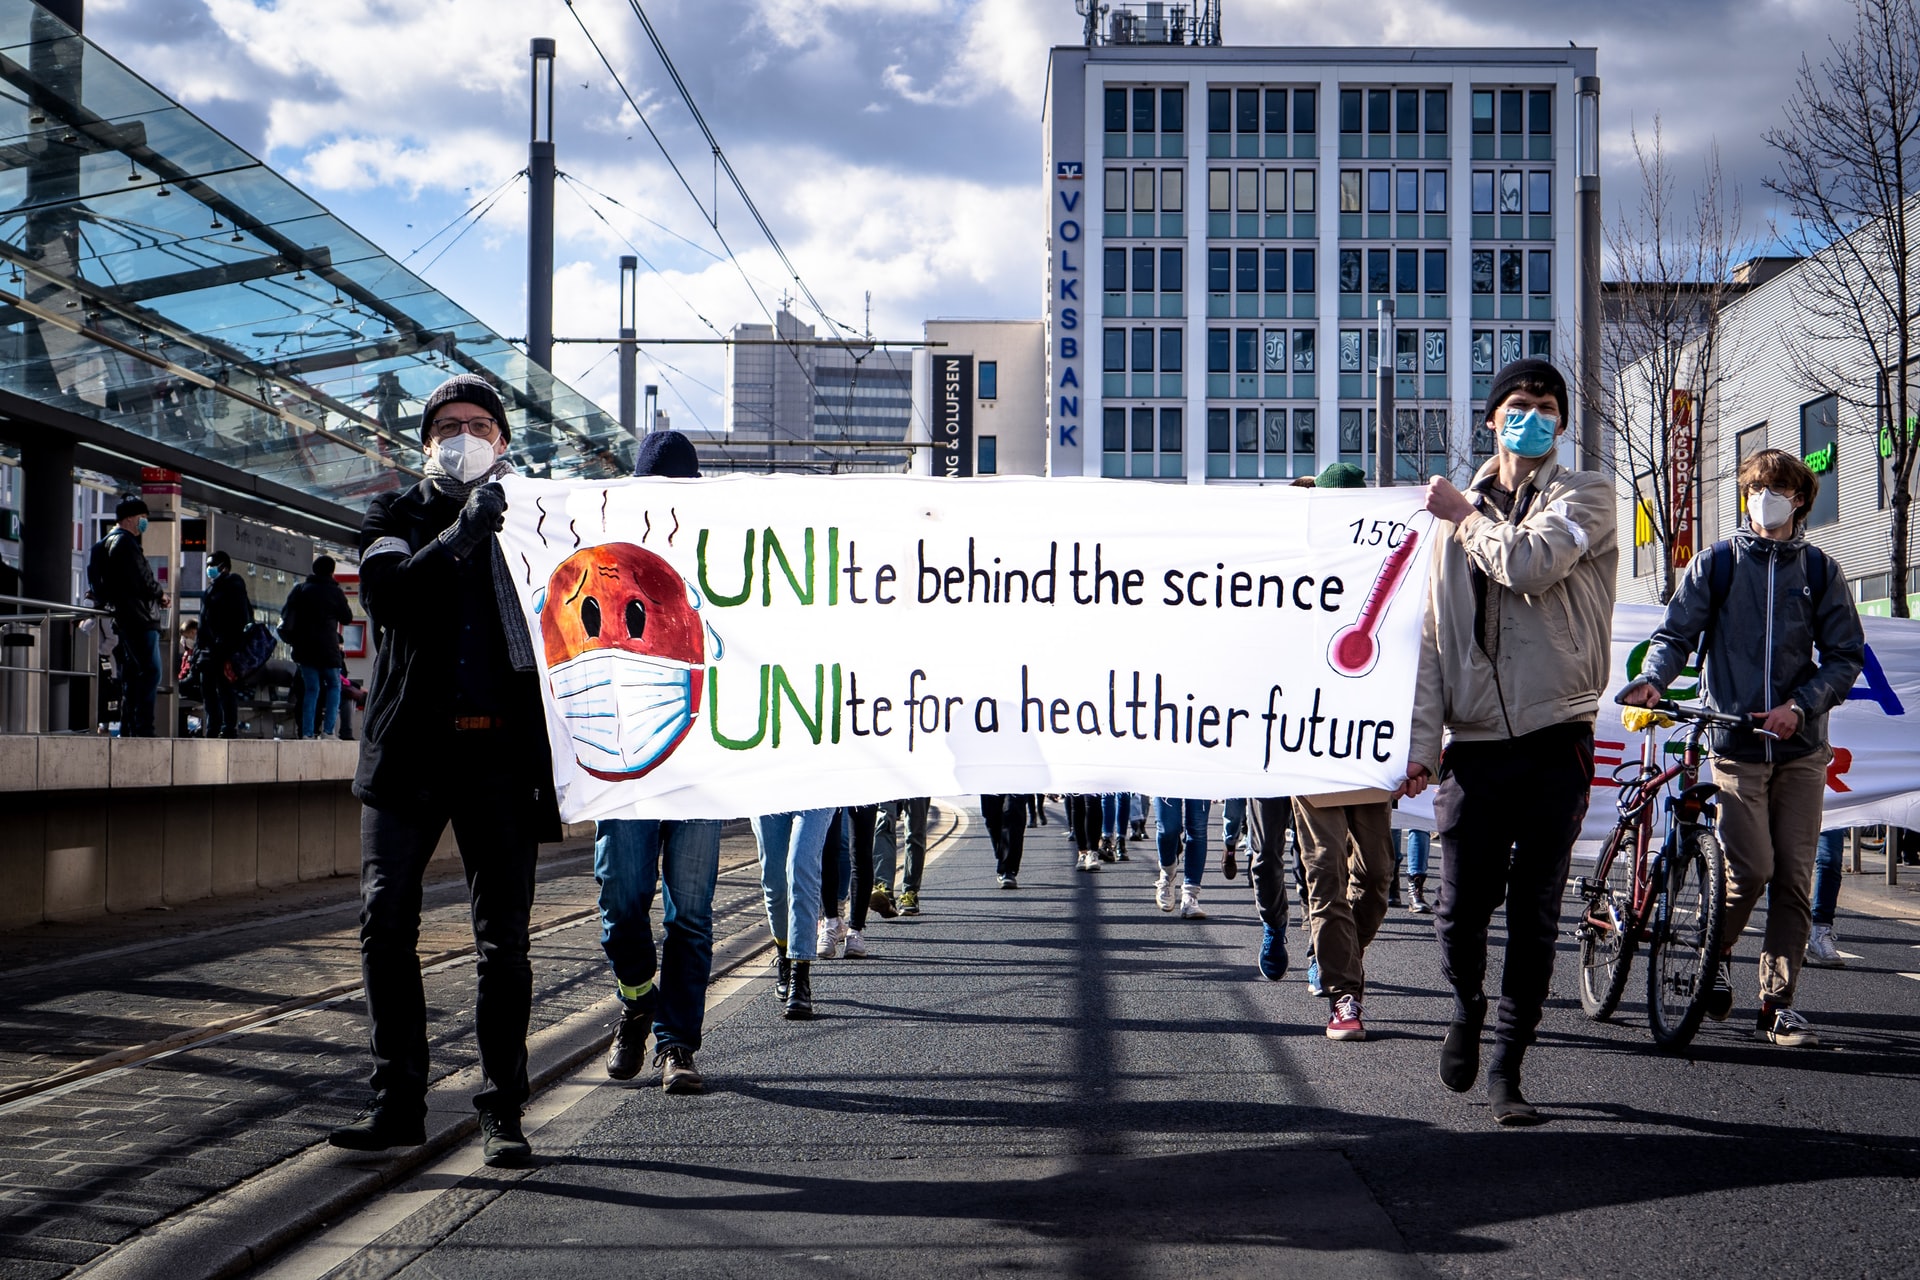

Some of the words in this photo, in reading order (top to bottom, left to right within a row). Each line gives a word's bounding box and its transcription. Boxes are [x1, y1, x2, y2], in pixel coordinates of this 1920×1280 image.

[1059, 190, 1080, 447] VOLKSBANK
[946, 360, 959, 434] OLUFSEN
[946, 439, 959, 449] &
[697, 526, 897, 607] UNIte
[917, 537, 1058, 605] behind
[1069, 542, 1145, 605] the
[1163, 562, 1345, 612] science
[708, 663, 892, 750] UNIte
[904, 669, 964, 753] for
[974, 696, 999, 734] a
[1021, 664, 1250, 748] healthier
[1262, 684, 1395, 770] future
